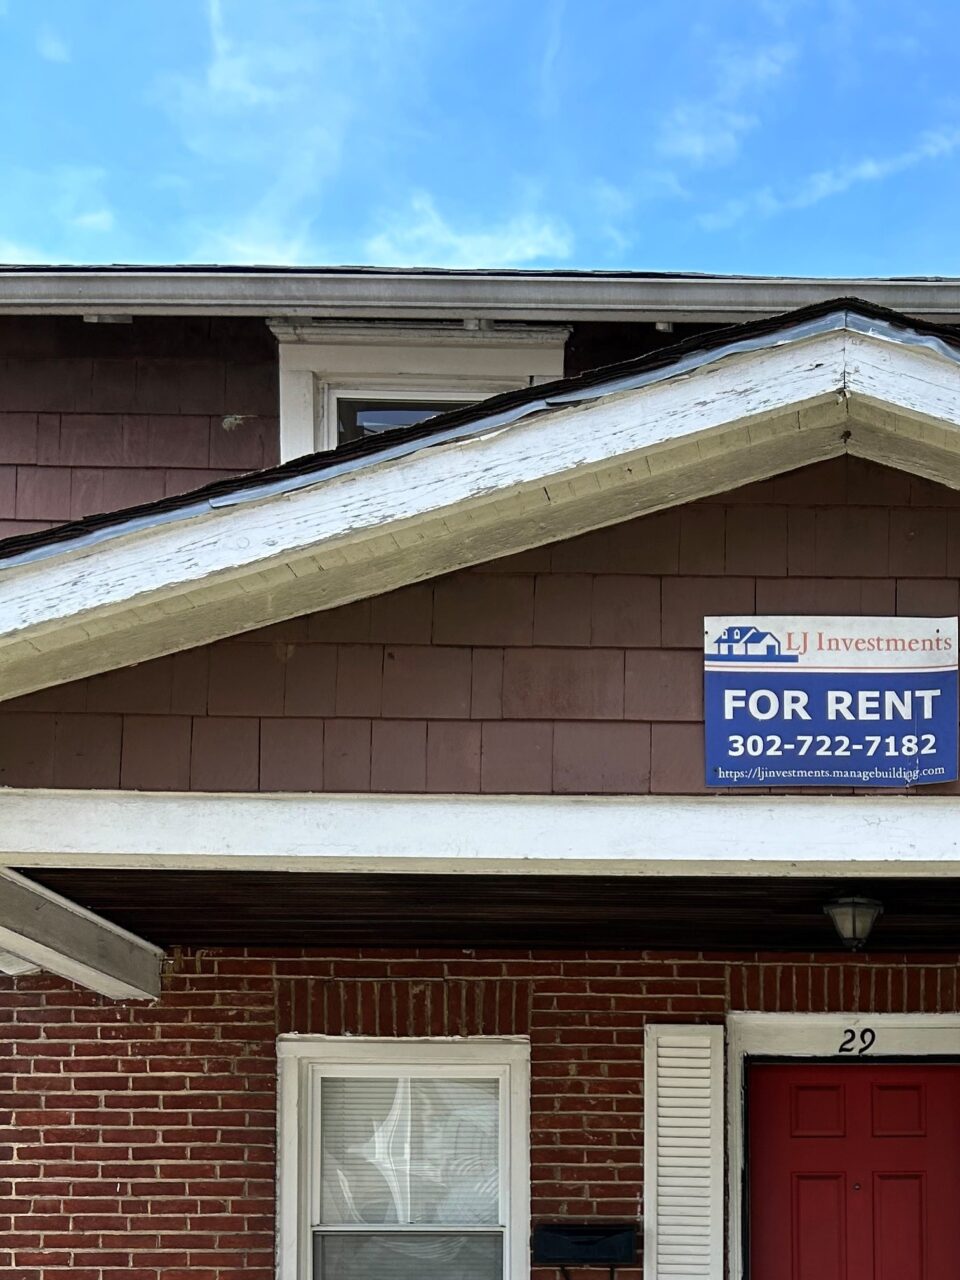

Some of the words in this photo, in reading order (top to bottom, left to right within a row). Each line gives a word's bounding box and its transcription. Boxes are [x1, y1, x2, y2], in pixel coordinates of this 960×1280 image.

[786, 632, 809, 655] LJ
[817, 632, 953, 651] Investments
[724, 689, 812, 720] FOR
[827, 689, 941, 720] RENT
[728, 734, 937, 757] 302-722-7182
[718, 765, 945, 781] https://ljinvestments.managebuilding.com
[838, 1028, 876, 1055] 29
